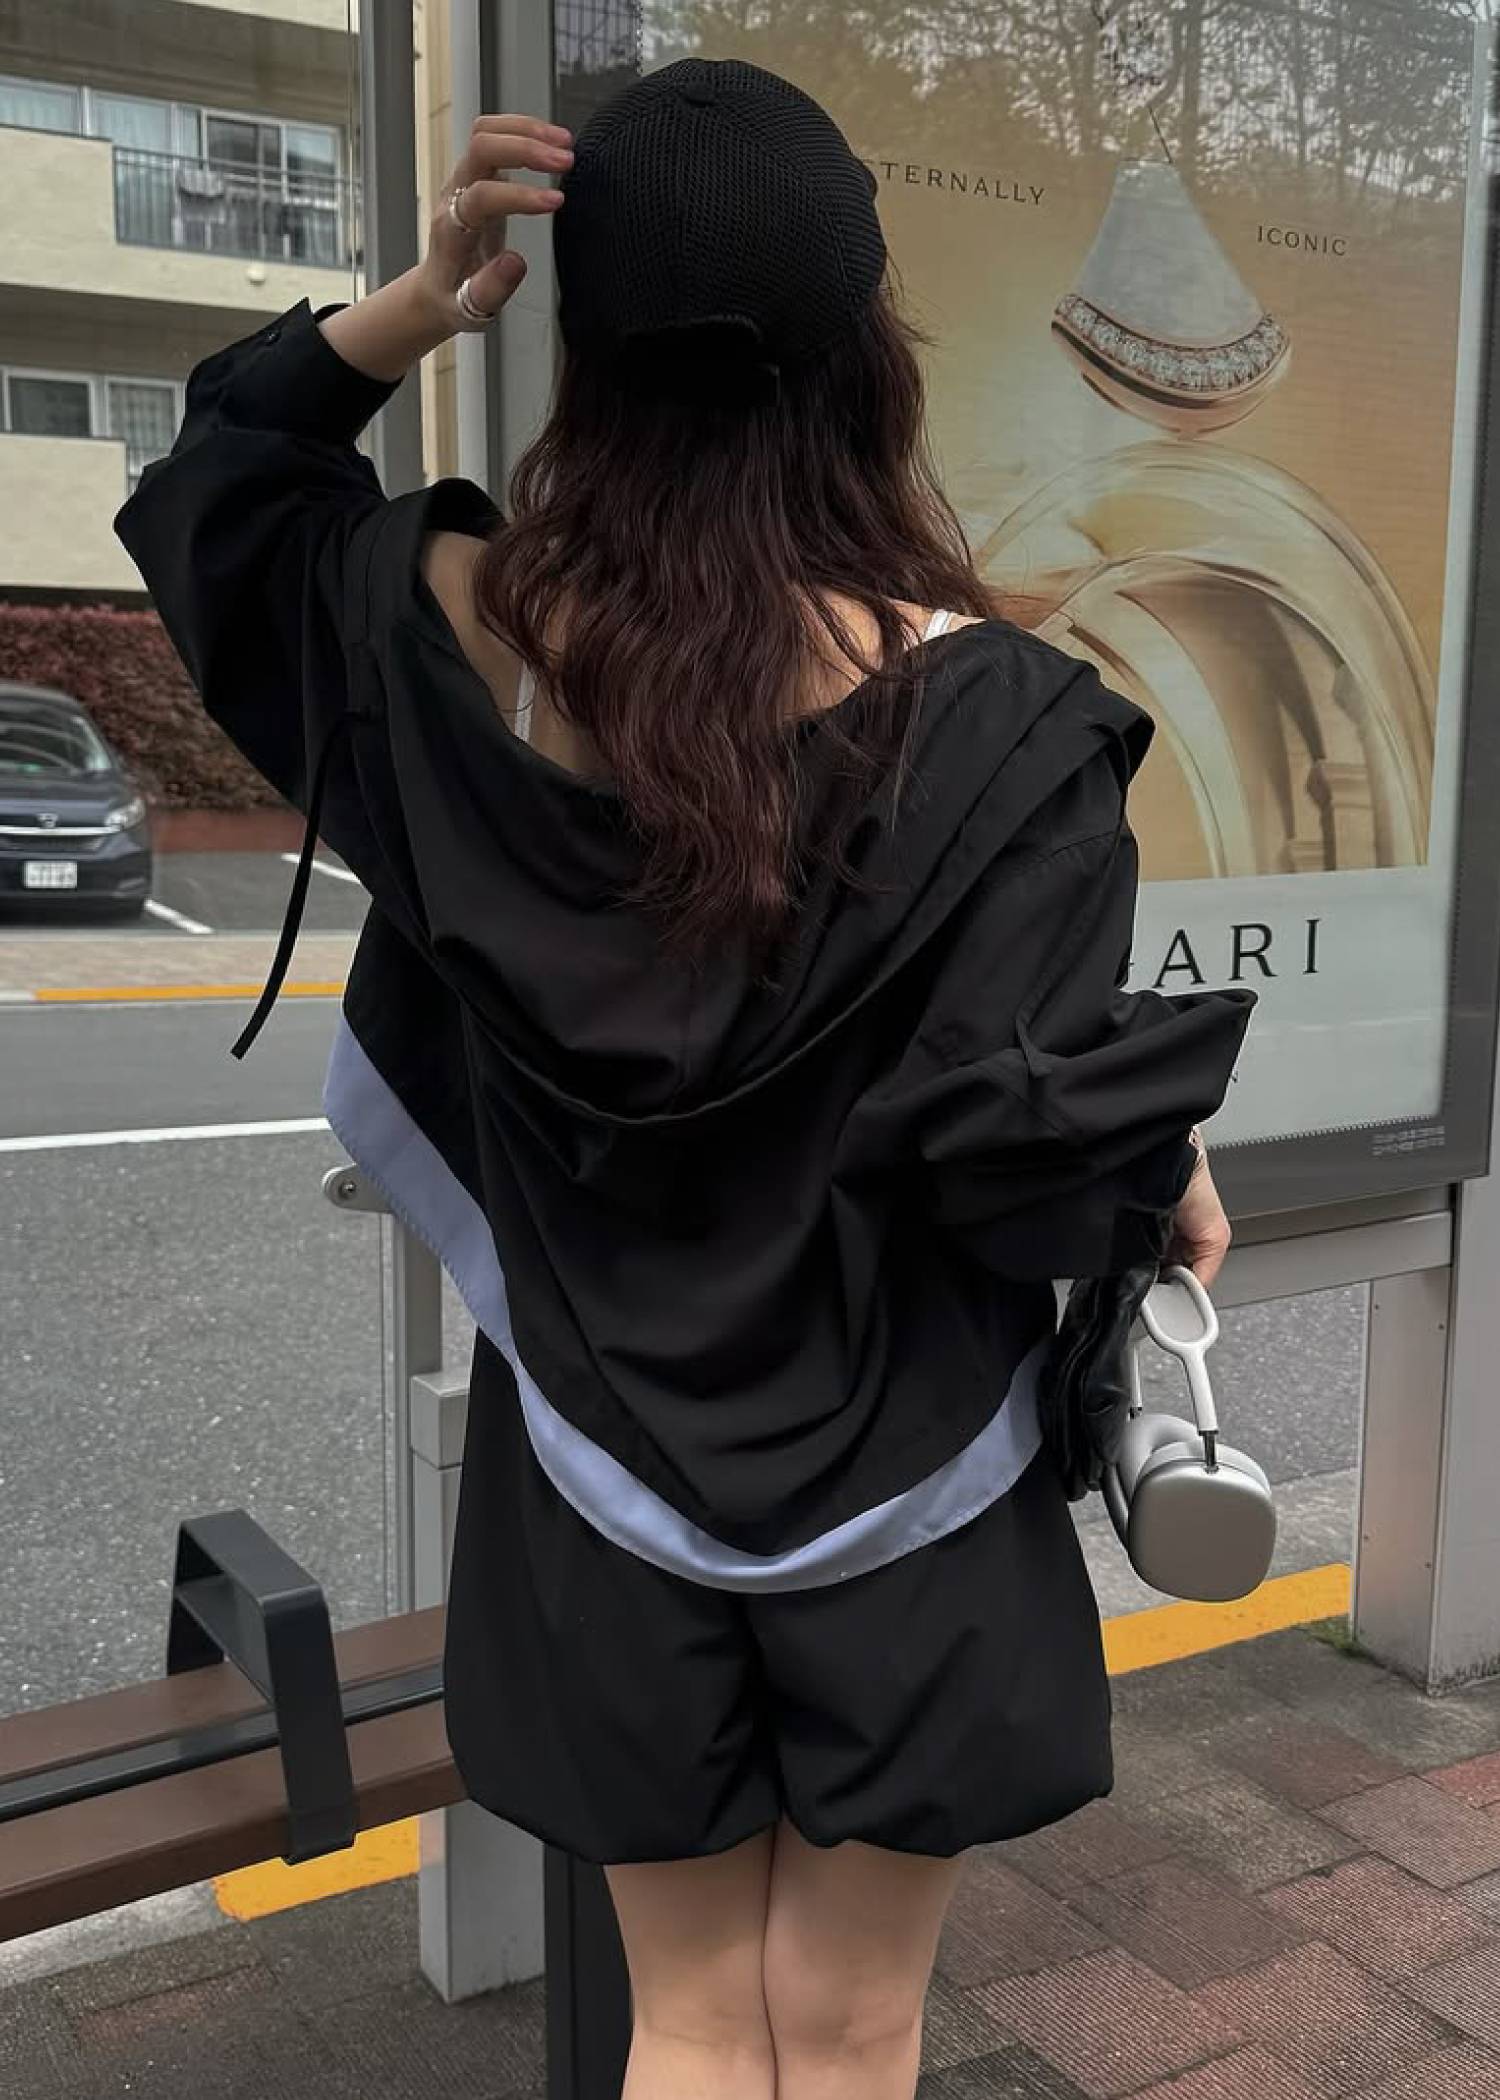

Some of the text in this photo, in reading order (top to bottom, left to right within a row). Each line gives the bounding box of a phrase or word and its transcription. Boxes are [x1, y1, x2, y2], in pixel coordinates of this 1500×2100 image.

[863, 159, 1045, 206] TERNALLY
[1257, 225, 1346, 256] ICONIC
[1130, 918, 1321, 989] ARI
